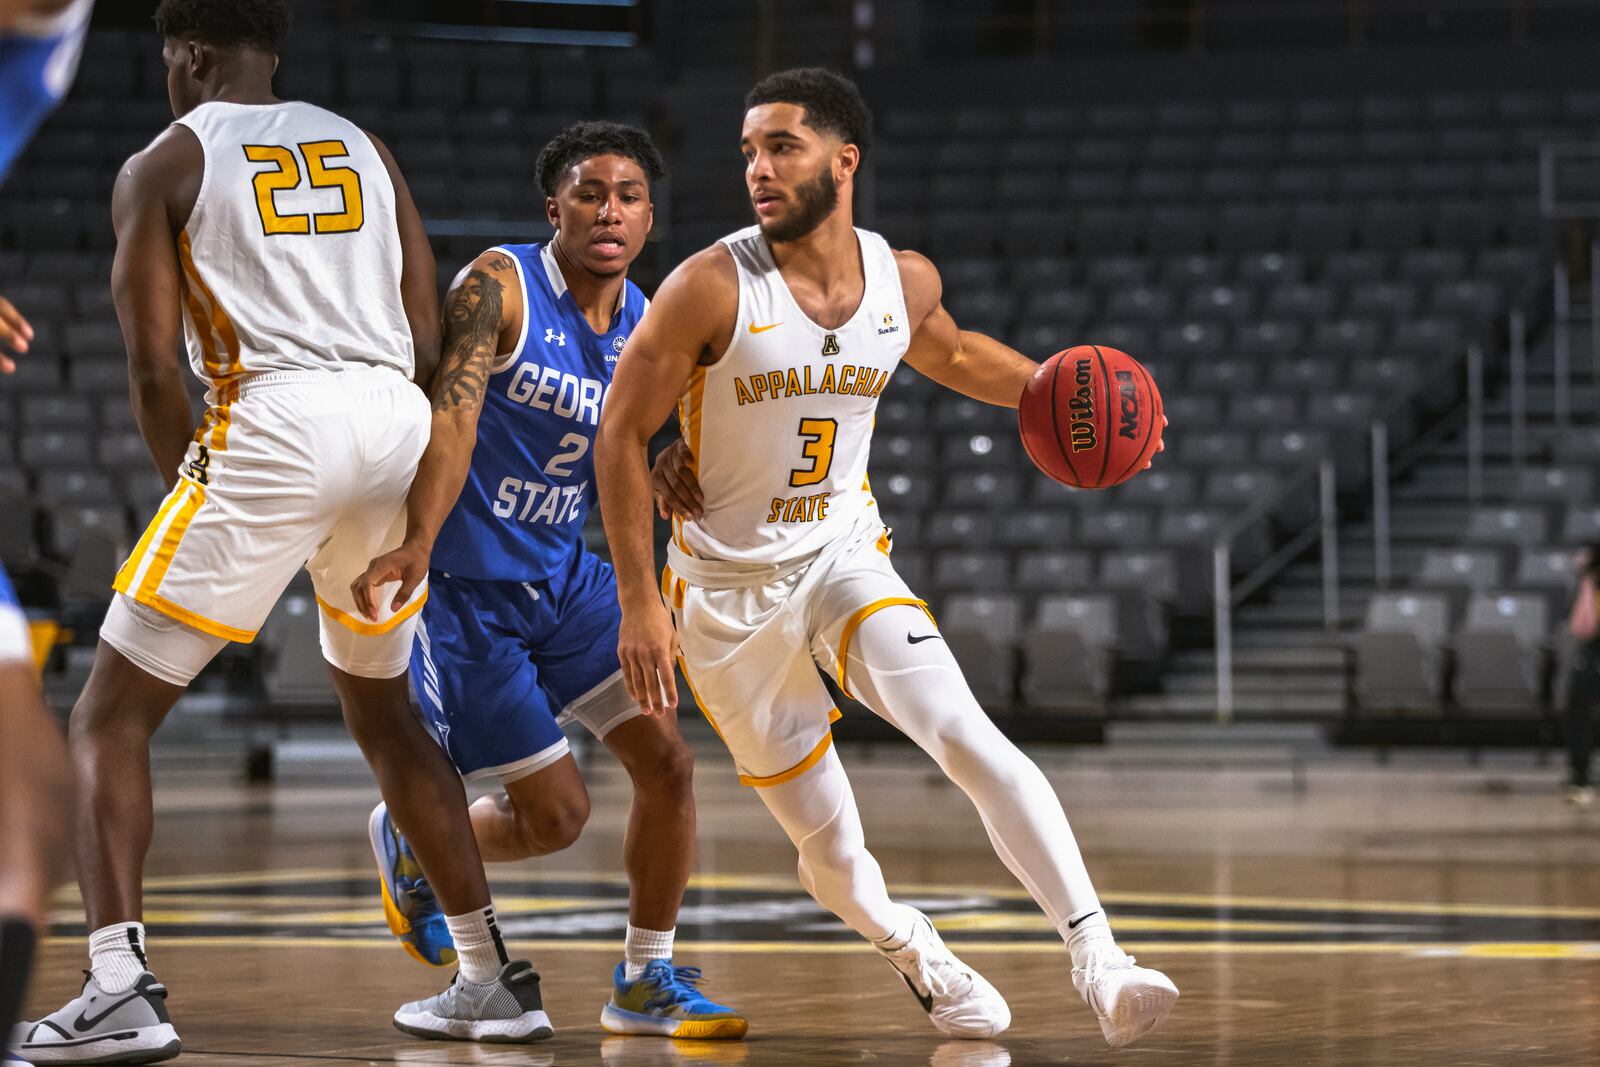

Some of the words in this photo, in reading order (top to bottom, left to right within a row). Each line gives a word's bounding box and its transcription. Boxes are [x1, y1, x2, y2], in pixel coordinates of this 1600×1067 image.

[242, 139, 364, 237] 25
[734, 363, 889, 406] APPALACHIA
[1069, 357, 1097, 454] Wilson
[1115, 370, 1138, 441] NCAA
[543, 432, 590, 478] 2
[789, 417, 839, 488] 3
[493, 476, 589, 525] STATE
[767, 492, 831, 524] STATE
